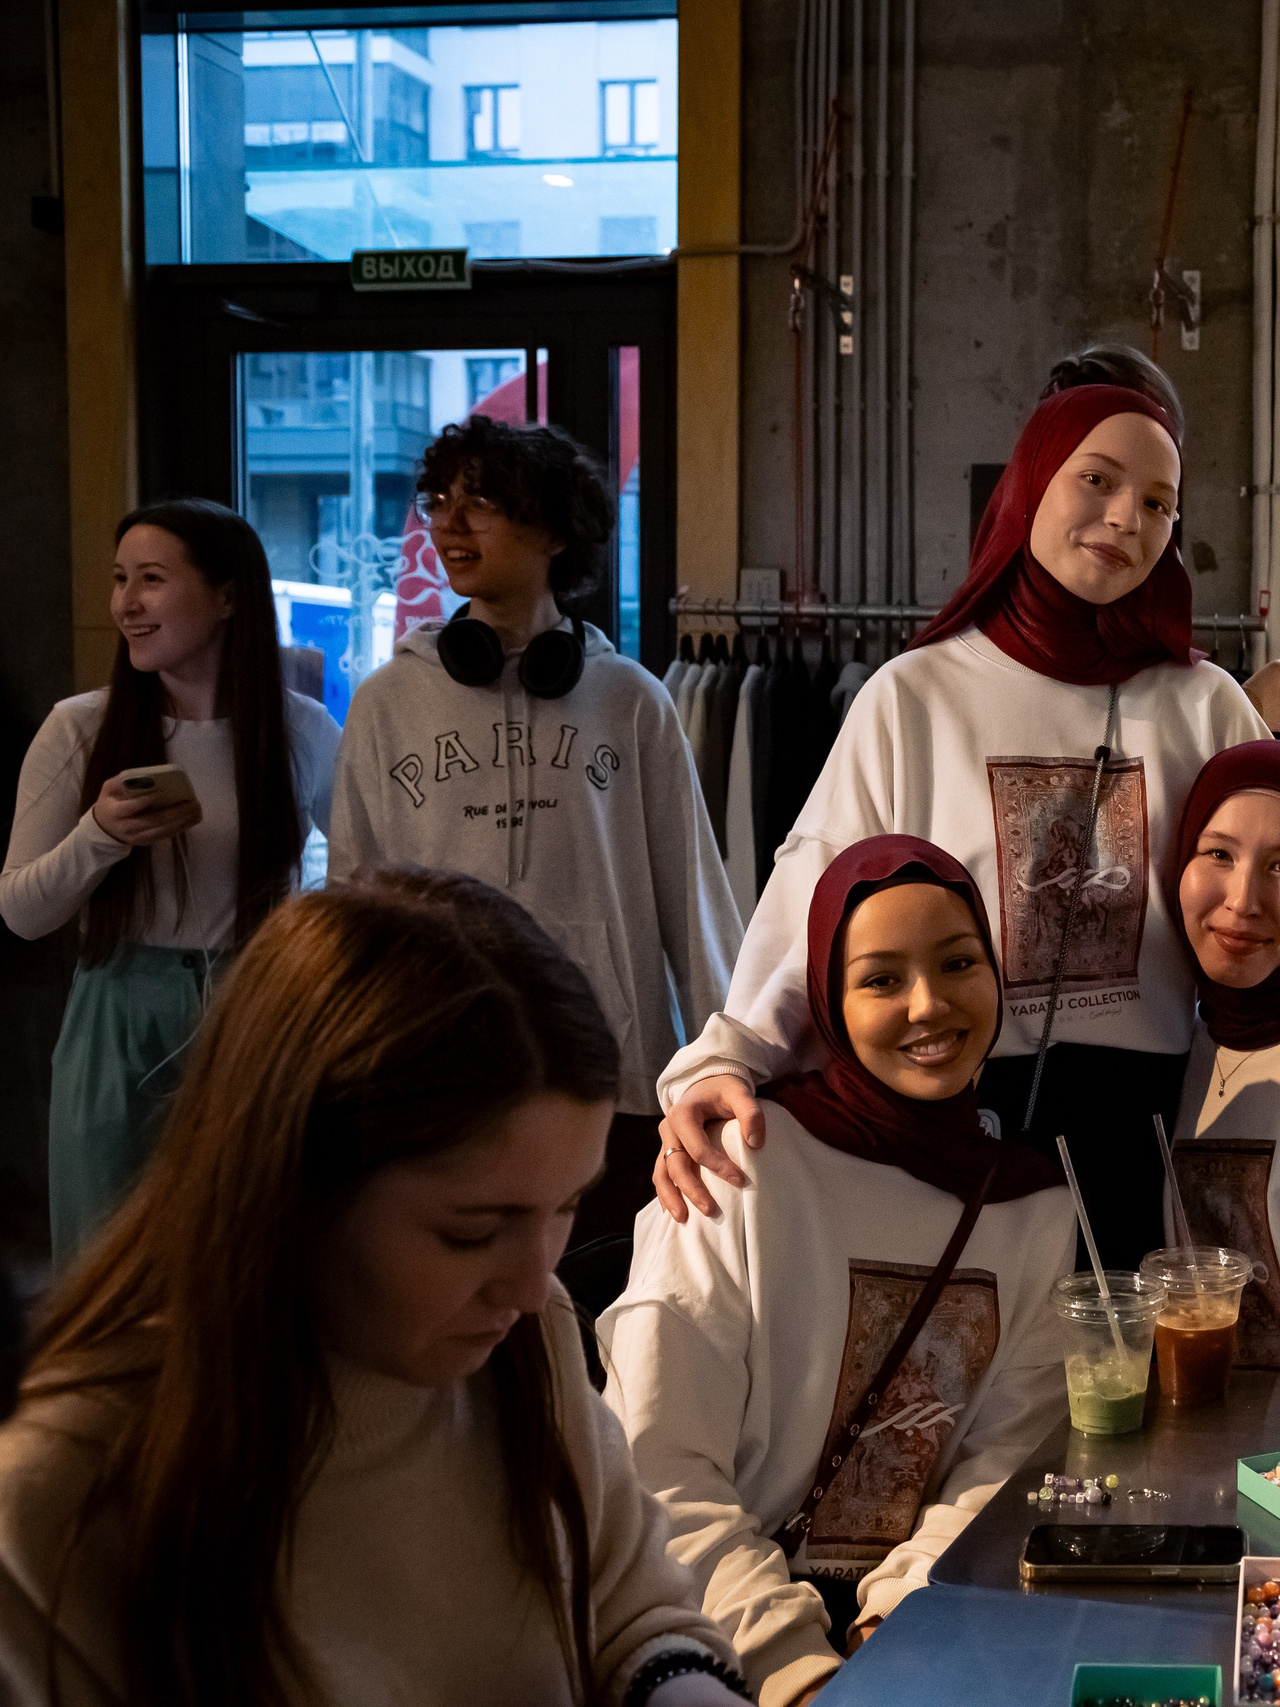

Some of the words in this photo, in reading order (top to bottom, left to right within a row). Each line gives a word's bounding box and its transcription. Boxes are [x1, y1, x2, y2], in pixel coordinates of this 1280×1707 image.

[361, 254, 456, 279] ВЫХОД
[389, 721, 620, 808] PARIS
[463, 805, 488, 819] RUE
[516, 799, 557, 813] RVOLI
[1068, 989, 1141, 1009] COLLECTION
